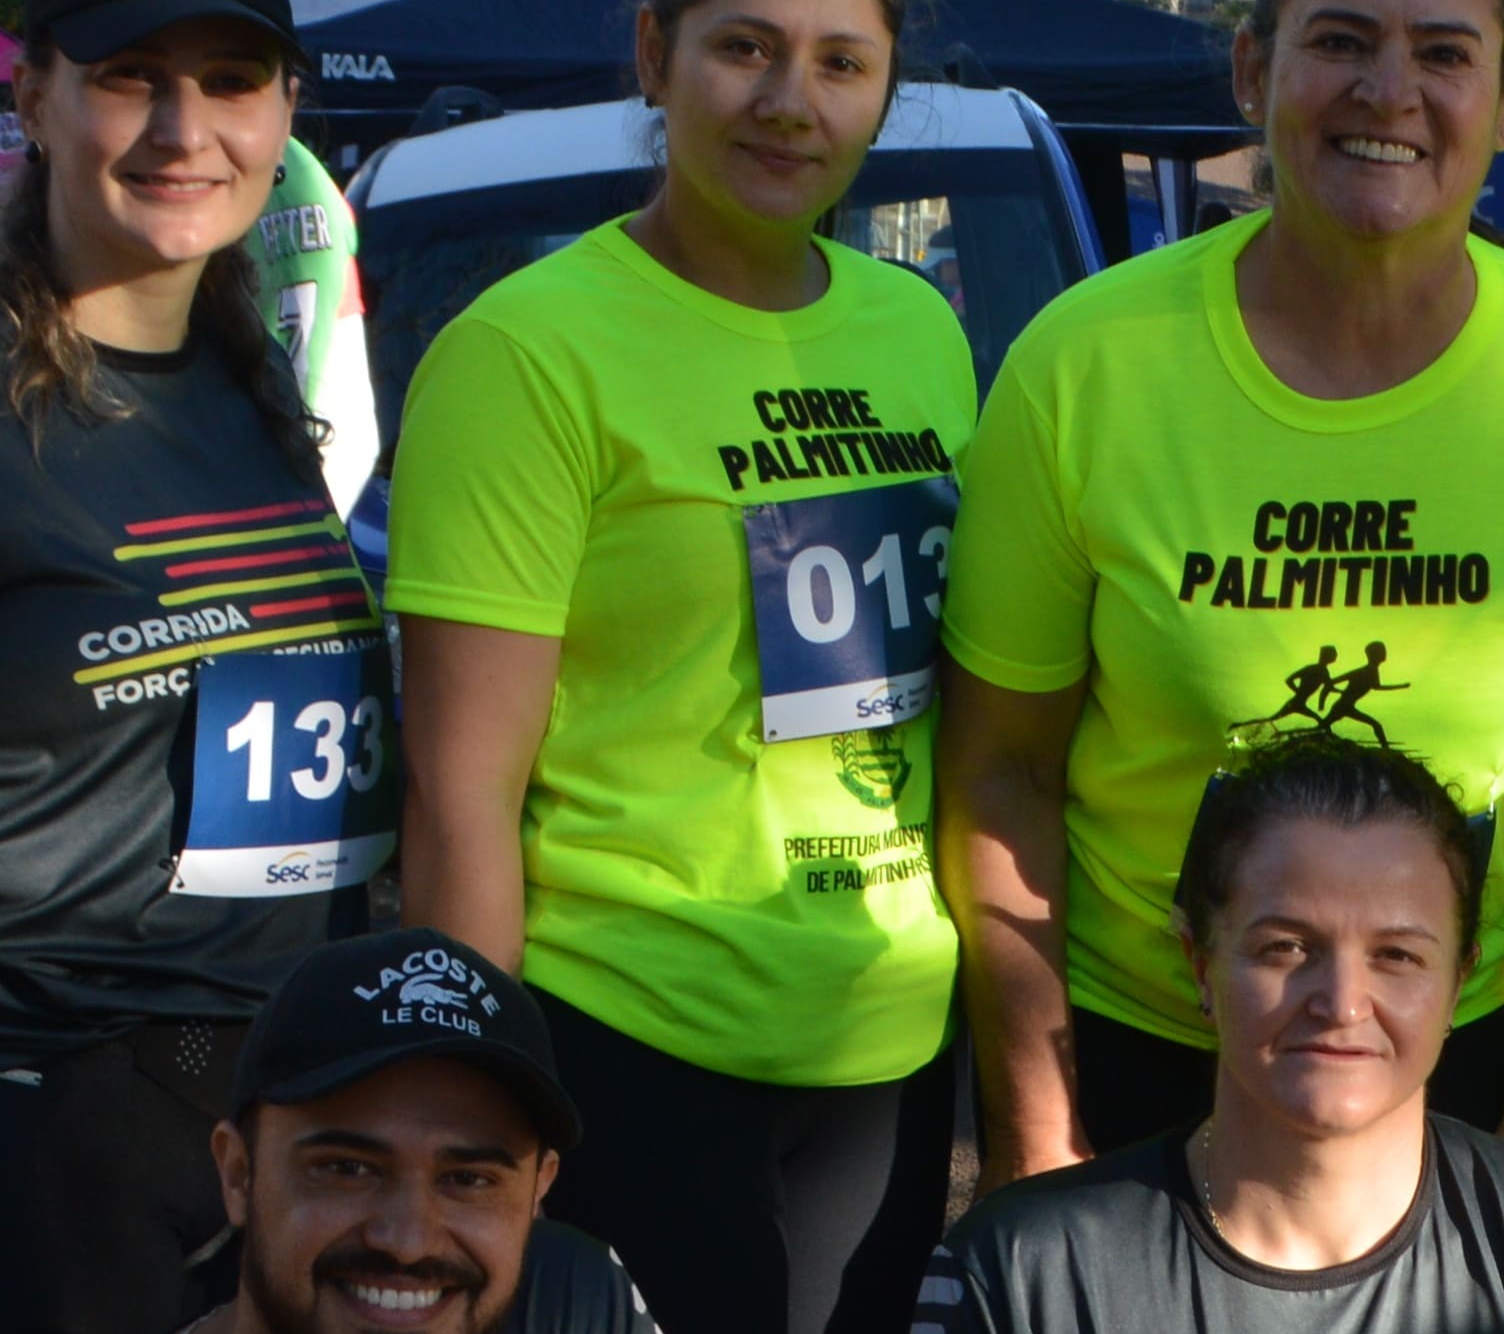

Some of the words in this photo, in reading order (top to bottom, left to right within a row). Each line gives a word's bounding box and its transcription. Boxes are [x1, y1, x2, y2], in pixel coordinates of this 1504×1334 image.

[321, 53, 395, 80] KALA
[753, 388, 883, 434] CORRE
[718, 428, 952, 491] PALMITINHO
[1253, 499, 1417, 553] CORRE
[787, 525, 951, 645] 013
[1178, 551, 1490, 609] PALMITINHO
[78, 604, 251, 661] CORRIDA
[227, 696, 384, 801] 133
[784, 830, 881, 860] PREFEITURA
[807, 871, 830, 893] DE
[834, 858, 916, 892] PALMITINH
[353, 949, 501, 1016] LACOSTE
[383, 1007, 412, 1024] LE
[420, 1006, 481, 1037] CLUB
